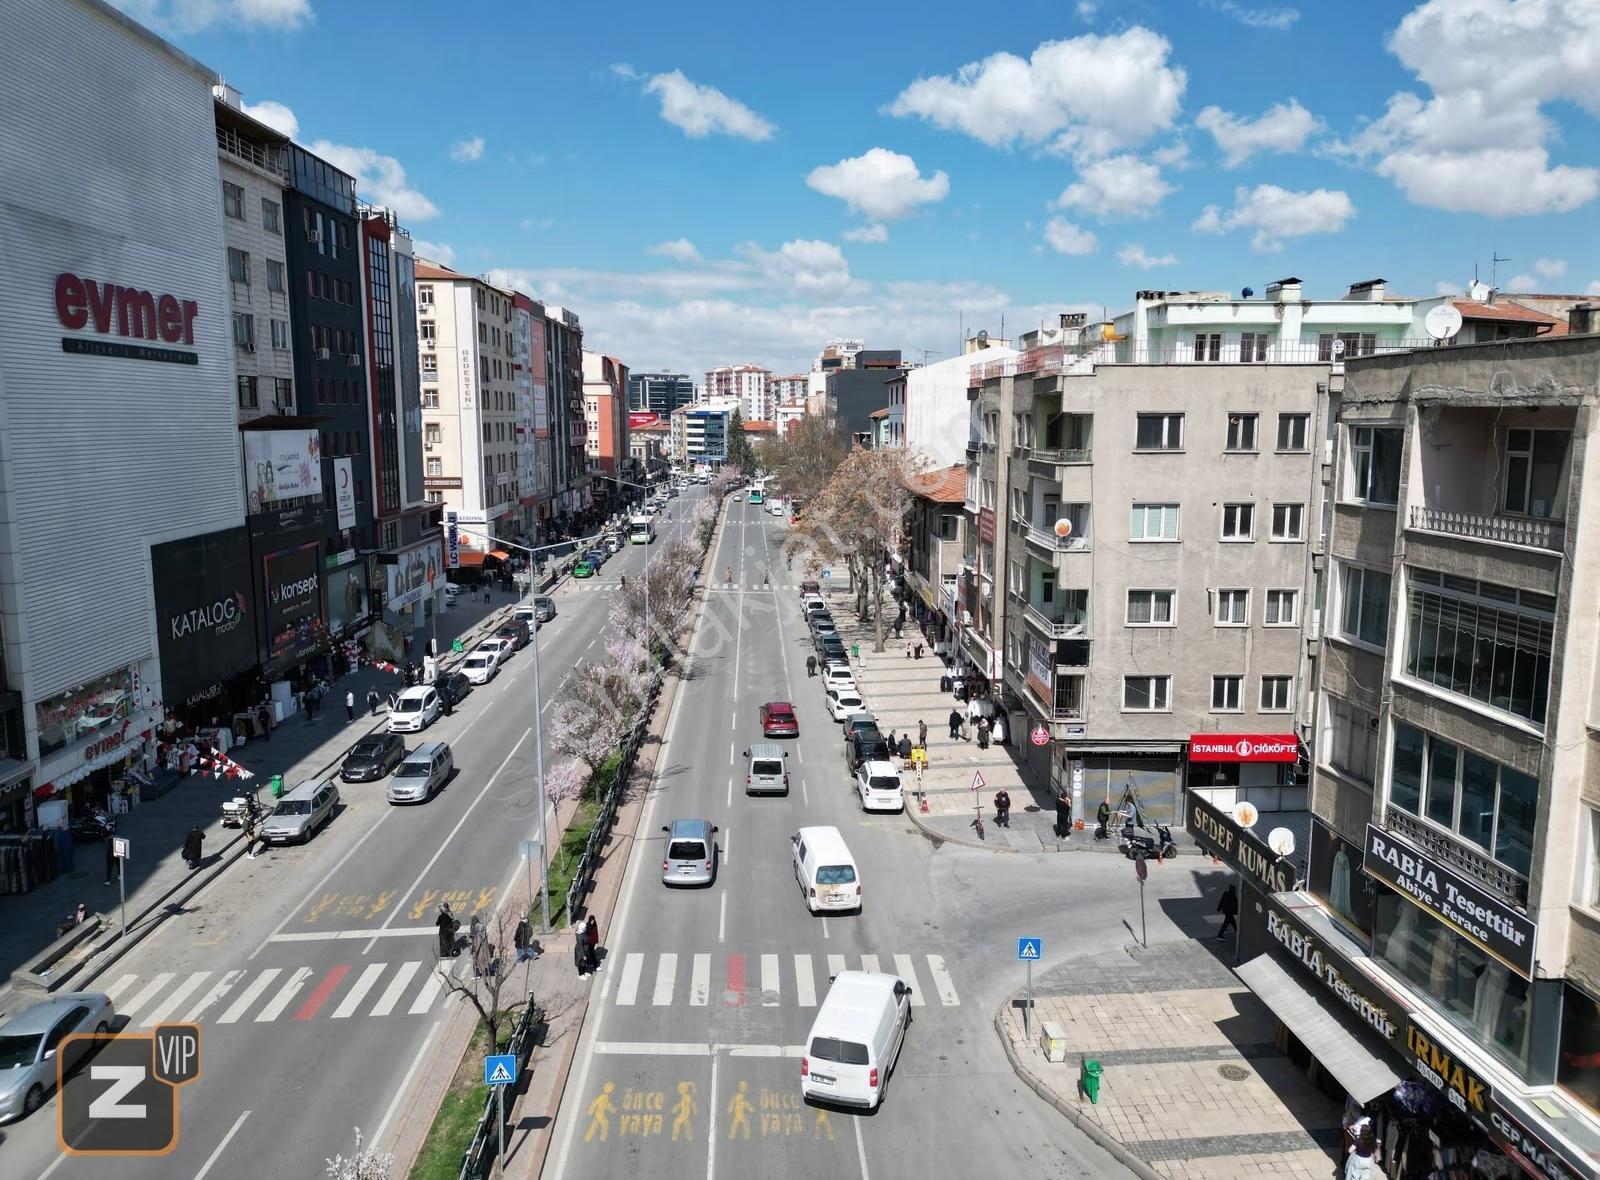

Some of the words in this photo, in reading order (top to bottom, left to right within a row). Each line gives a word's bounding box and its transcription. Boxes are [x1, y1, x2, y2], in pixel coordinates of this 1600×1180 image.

[55, 272, 198, 345] evmer
[462, 349, 472, 403] BEDESTEN
[281, 572, 318, 601] konsept
[171, 598, 235, 640] KATALOG
[215, 621, 236, 637] moda
[1193, 743, 1235, 753] İSTANBUL
[1253, 742, 1297, 755] ÇİĞKÖFTE
[1194, 806, 1234, 852] SEDEF
[1372, 835, 1439, 894] RABİA
[1446, 882, 1525, 947] Tesettür
[1396, 874, 1433, 907] Abiye
[1441, 902, 1489, 943] Ferace
[1266, 909, 1324, 977] RABİA
[1325, 964, 1397, 1039] Tesettür
[1407, 1025, 1486, 1113] IRMAK
[623, 1088, 664, 1110] önce
[620, 1113, 664, 1137] yaya
[1490, 1112, 1520, 1143] CEP
